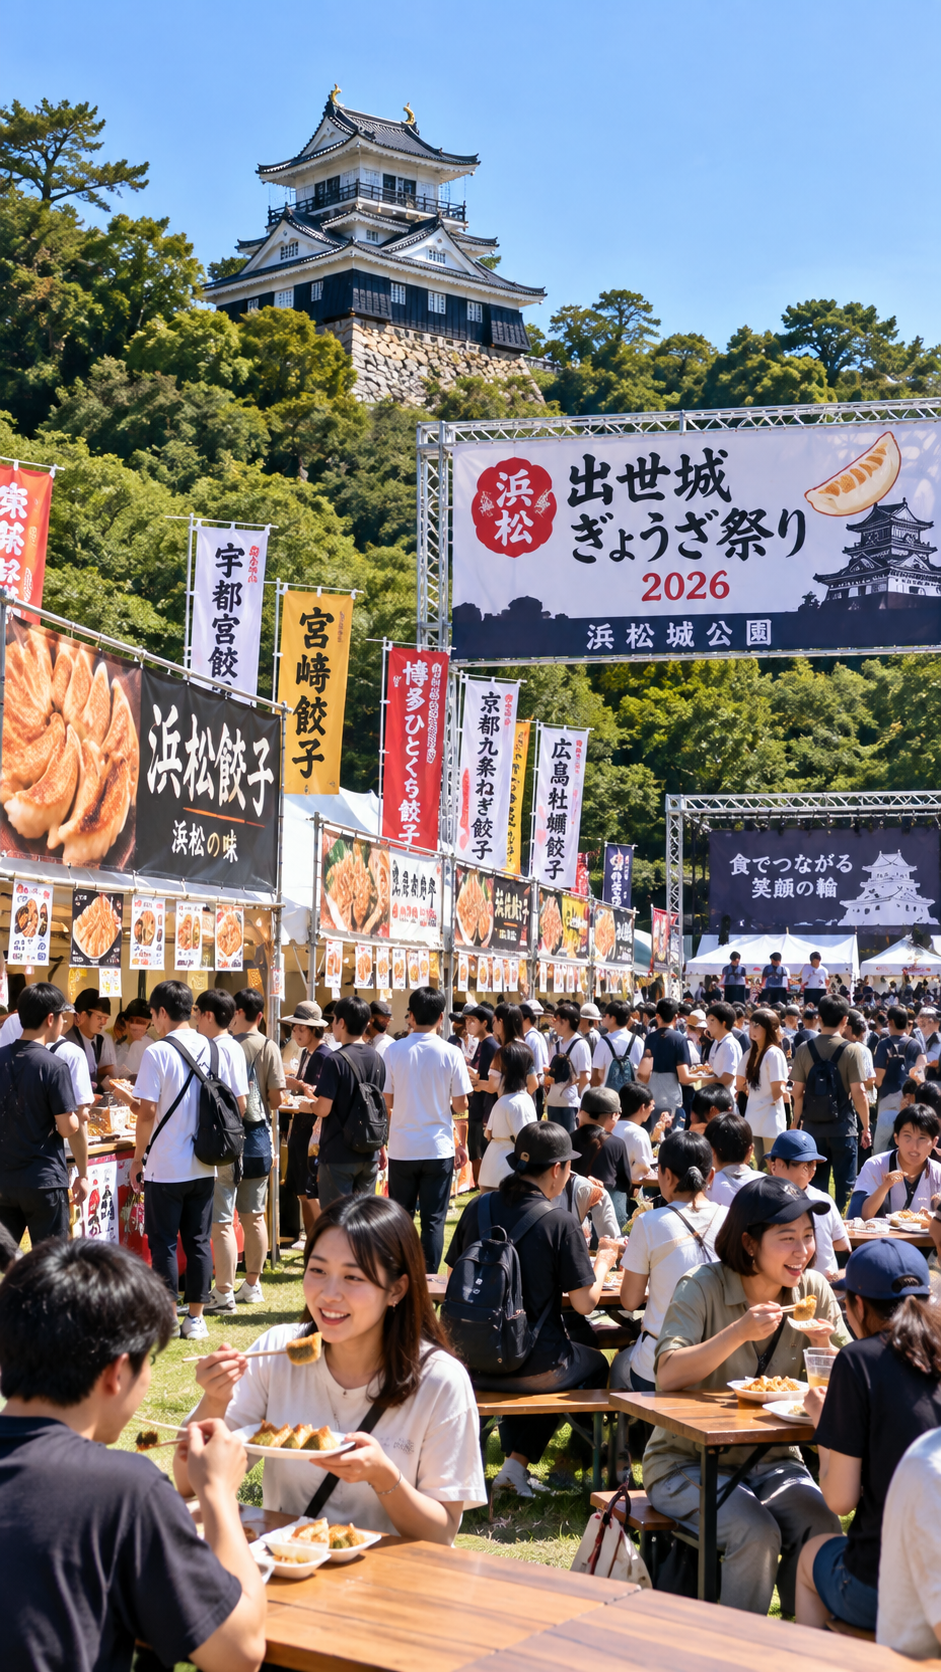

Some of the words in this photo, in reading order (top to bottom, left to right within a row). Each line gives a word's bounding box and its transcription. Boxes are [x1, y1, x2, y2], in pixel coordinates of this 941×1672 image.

[566, 447, 732, 507] 出世城
[494, 468, 534, 546] 浜松
[569, 506, 806, 564] ぎょうざ祭り
[641, 569, 730, 602] 2026
[586, 619, 773, 650] 浜松城公園
[147, 704, 275, 817] 浜松餃子
[398, 659, 428, 845] 博多ひとくち餃子
[471, 691, 502, 861] 京都九条ねぎ餃子
[172, 820, 239, 863] 浜松の味
[729, 853, 853, 876] 食でつながる
[751, 876, 838, 899] 笑顔の輪
